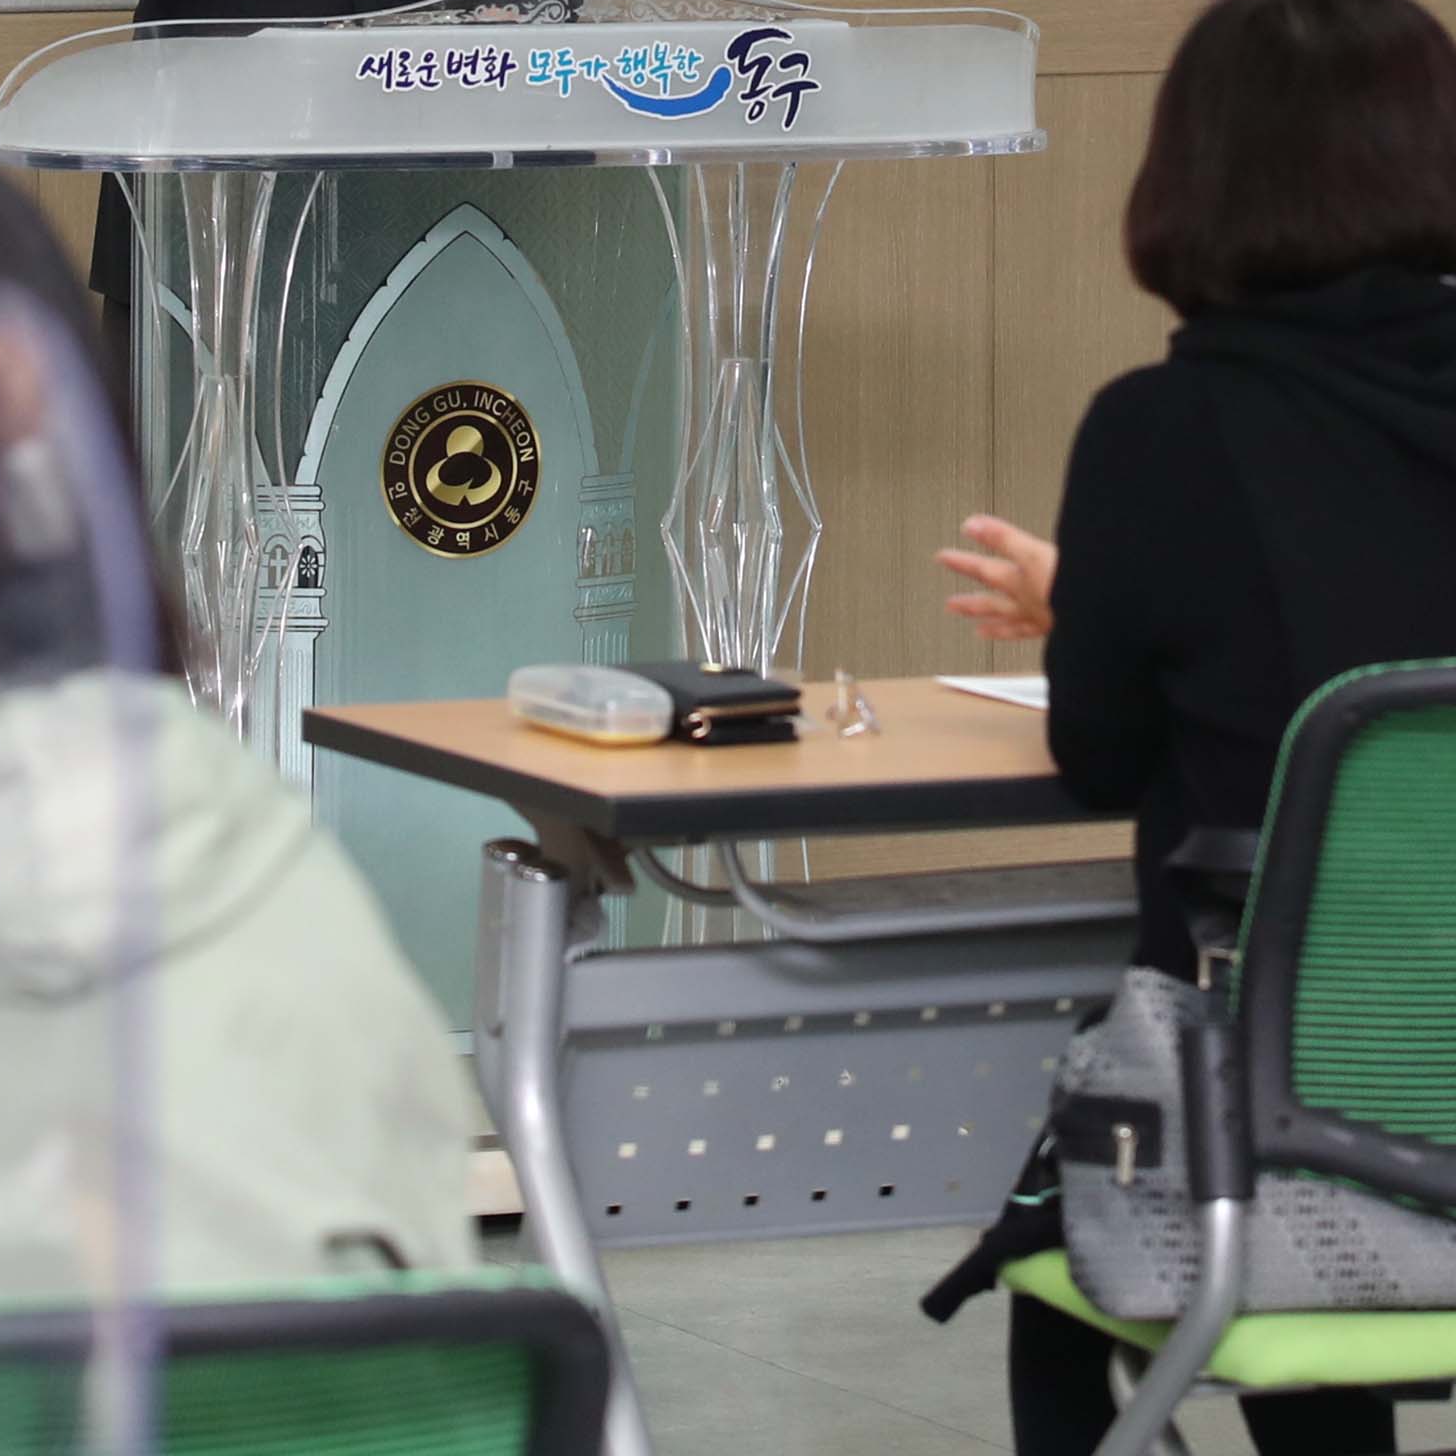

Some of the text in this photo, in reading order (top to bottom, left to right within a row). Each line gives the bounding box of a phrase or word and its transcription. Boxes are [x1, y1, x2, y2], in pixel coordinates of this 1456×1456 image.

[359, 27, 820, 129] 새로운 변화 모두가 행복한 동구
[389, 408, 431, 466] DONG
[473, 390, 535, 463] INCHEON
